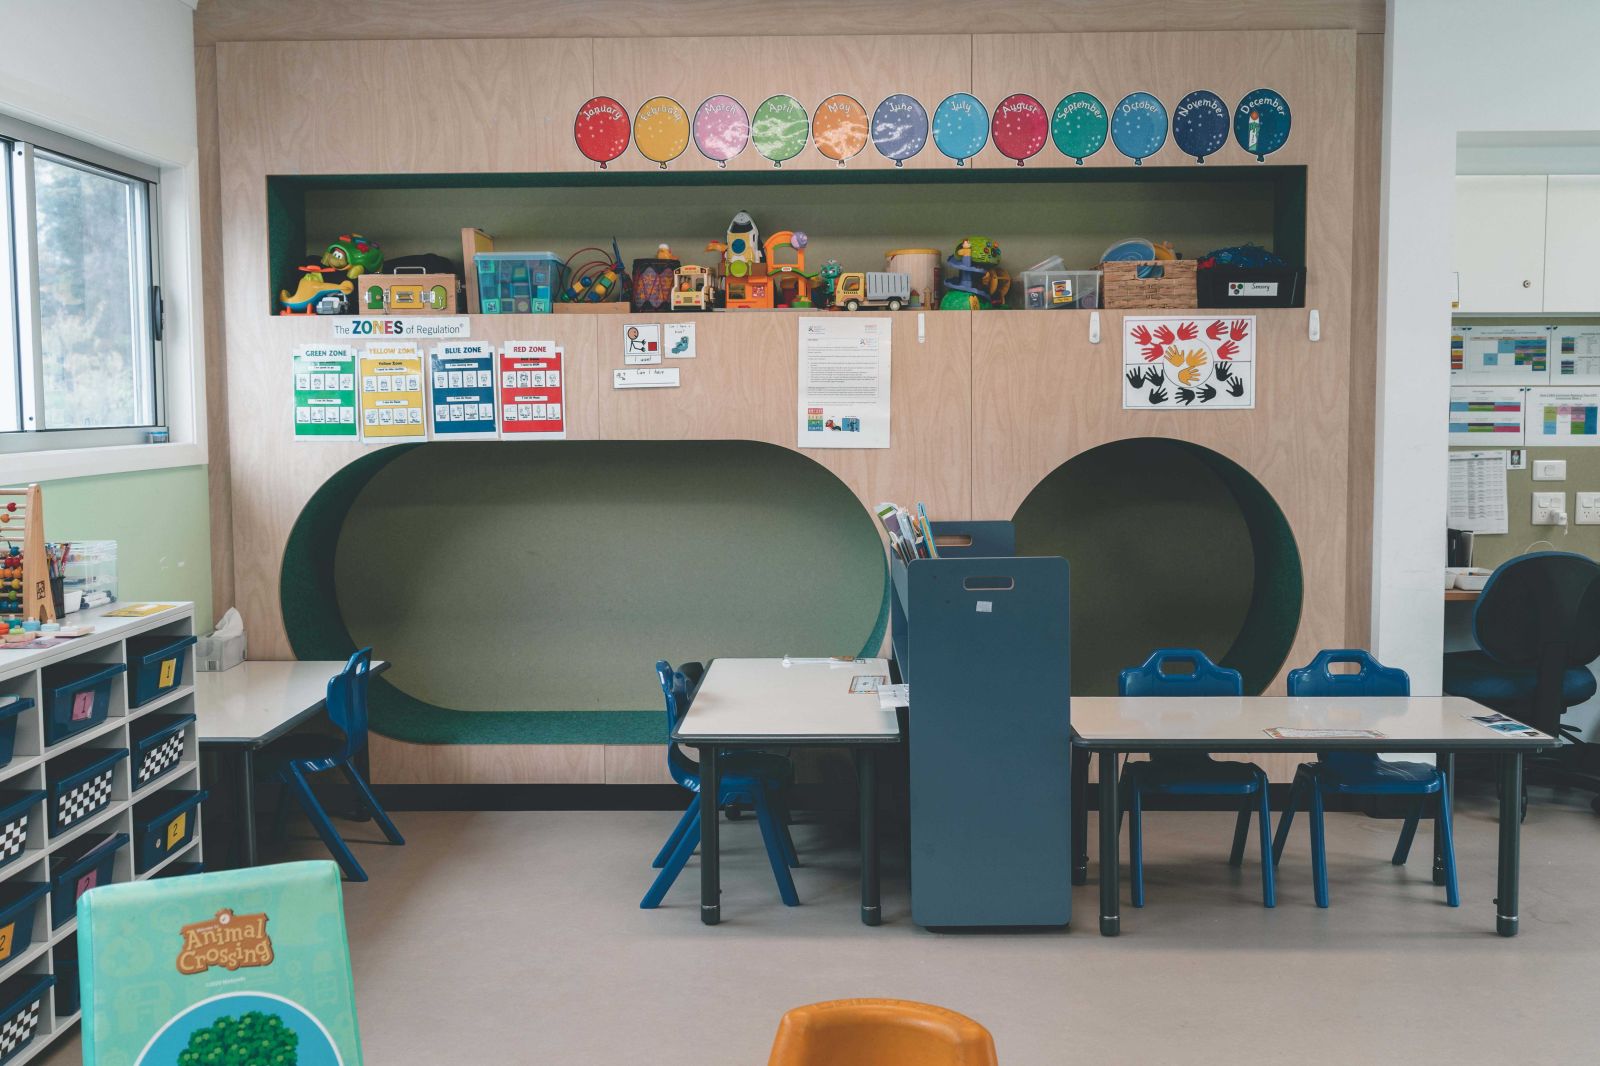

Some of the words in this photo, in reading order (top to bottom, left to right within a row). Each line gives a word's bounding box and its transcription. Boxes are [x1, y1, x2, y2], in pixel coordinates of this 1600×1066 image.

[582, 104, 622, 121] January
[704, 102, 738, 114] March
[769, 102, 793, 114] April
[827, 102, 851, 115] May
[888, 102, 913, 113] June
[950, 101, 972, 113] July
[1001, 102, 1039, 117] August
[1057, 99, 1102, 120] September
[1122, 101, 1159, 114] October
[1178, 99, 1224, 118] November
[1240, 97, 1285, 116] December
[335, 326, 350, 334] The
[352, 320, 403, 334] ZONES
[406, 326, 414, 334] of
[81, 695, 87, 713] 1
[173, 823, 178, 836] 2
[186, 919, 263, 950] Animal
[180, 941, 271, 970] Crossing
